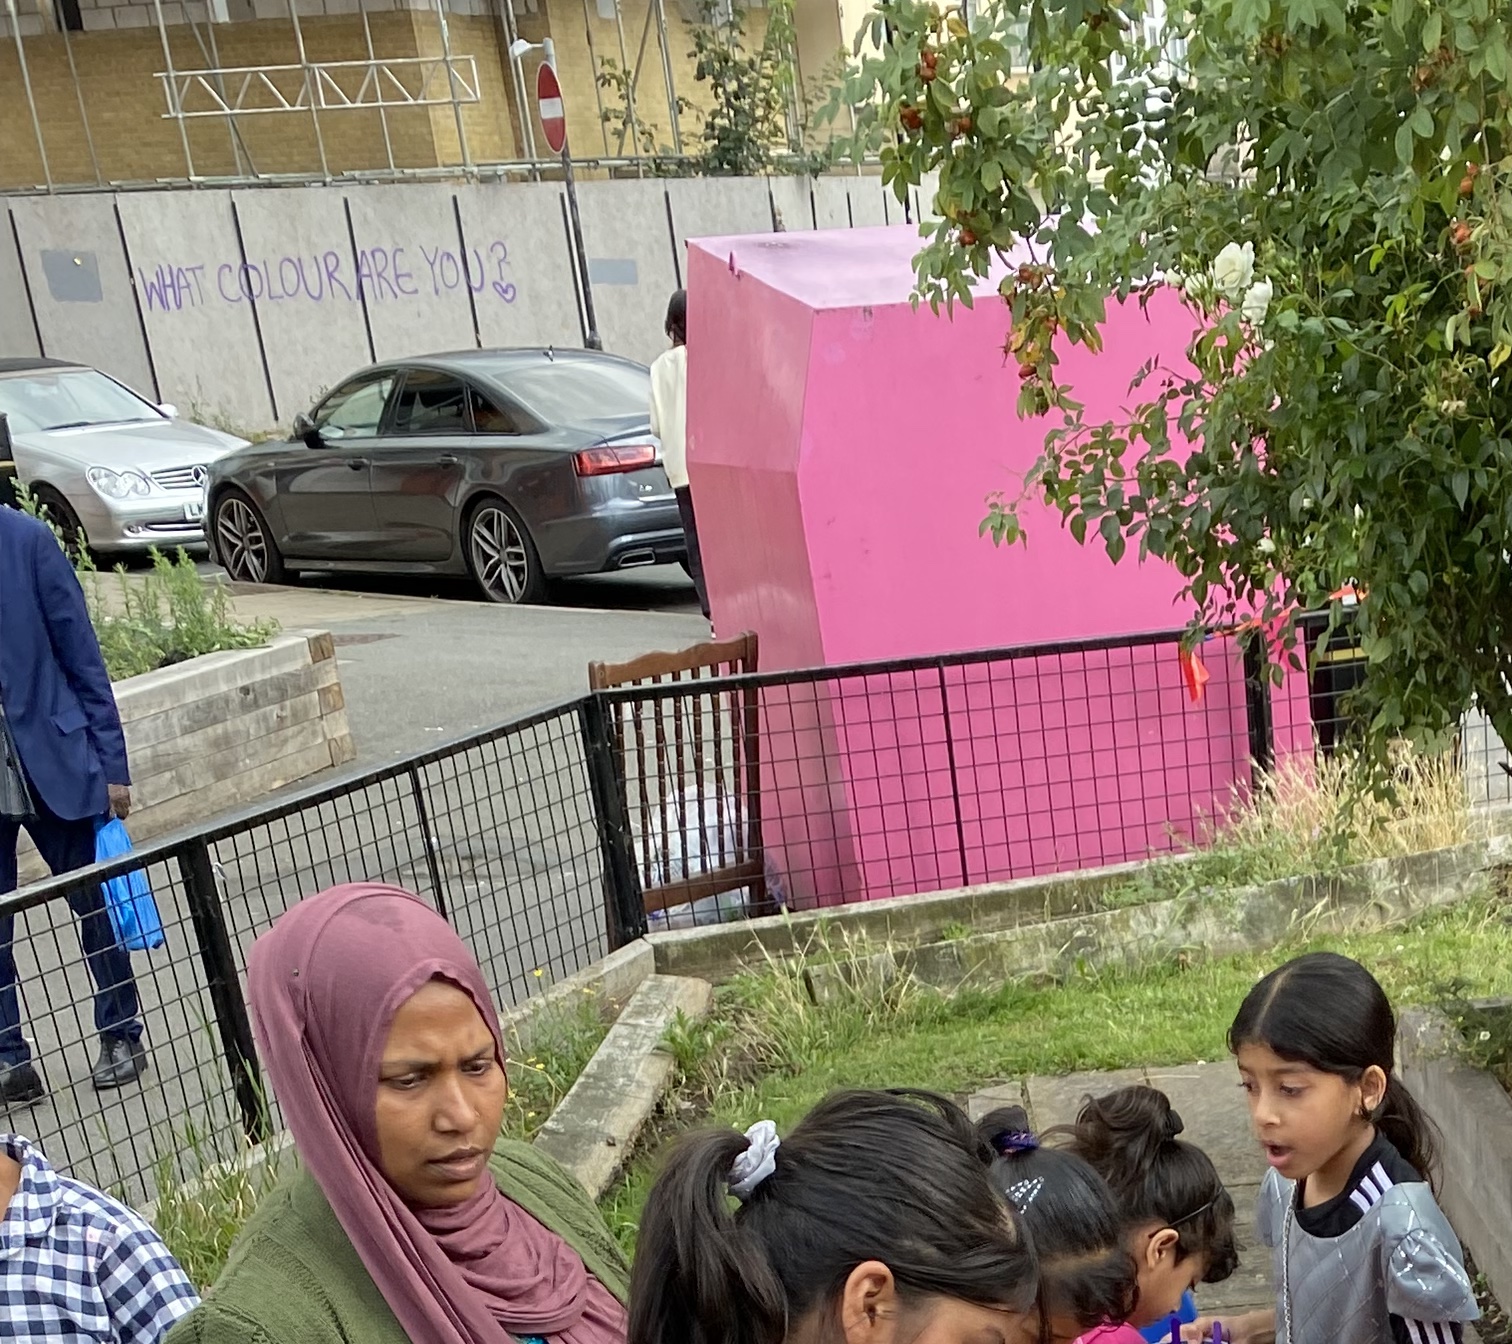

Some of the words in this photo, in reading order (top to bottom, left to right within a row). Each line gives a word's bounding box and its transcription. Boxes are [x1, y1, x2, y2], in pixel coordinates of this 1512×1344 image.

[138, 263, 205, 311] WHAT
[218, 251, 350, 301] COLOUR
[357, 248, 418, 300] ARE
